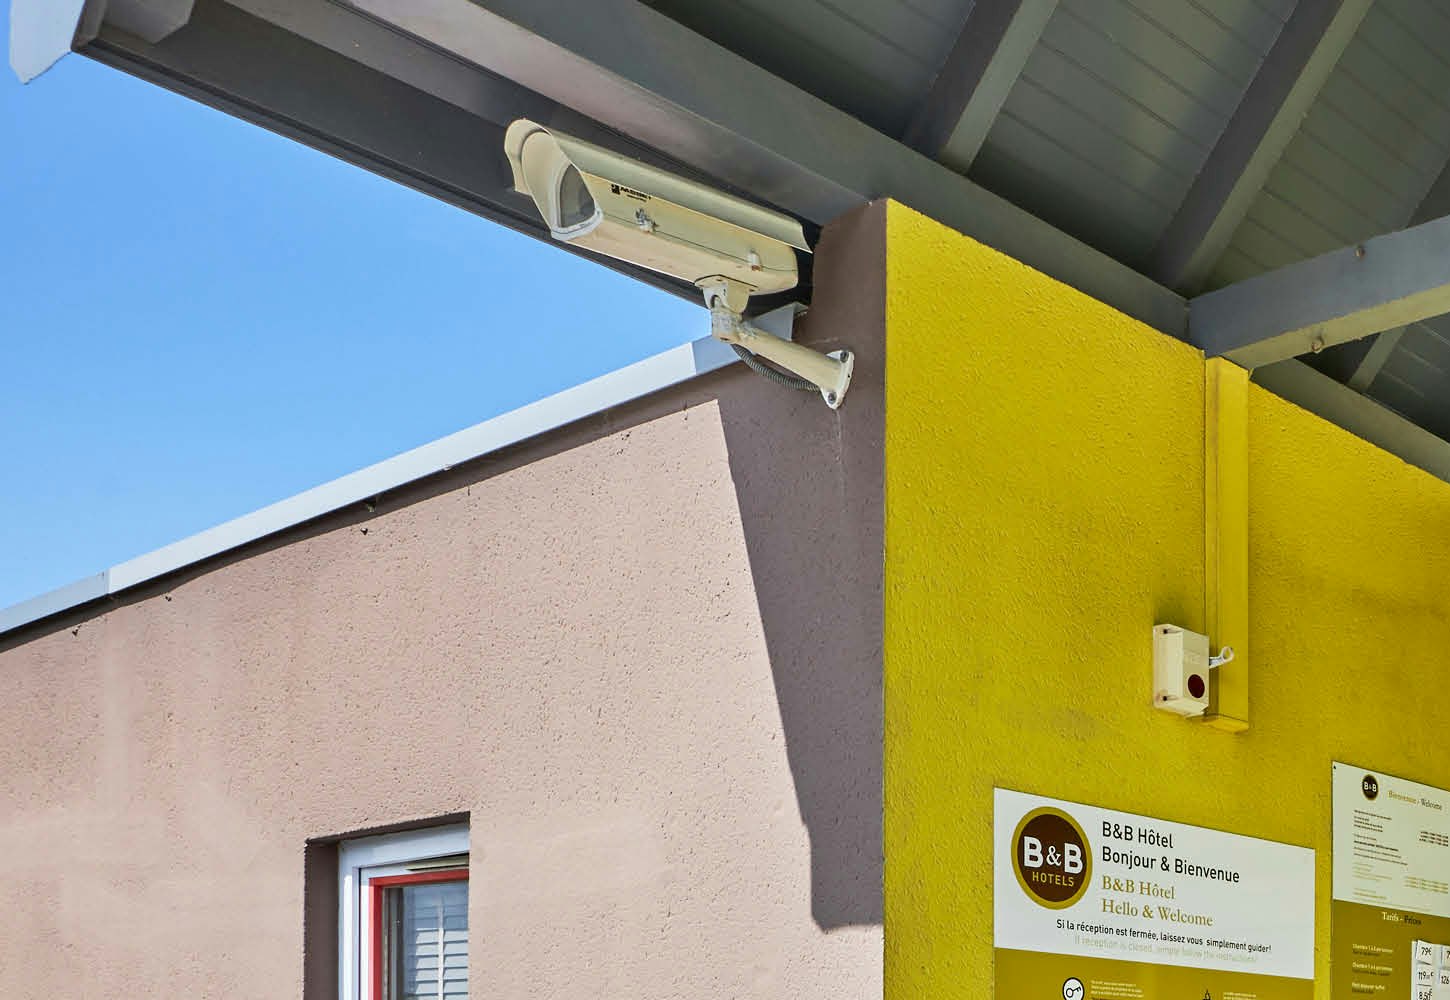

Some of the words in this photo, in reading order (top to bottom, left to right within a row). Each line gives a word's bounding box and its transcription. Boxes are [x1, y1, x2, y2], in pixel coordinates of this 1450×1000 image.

[1102, 821, 1133, 841] B&B
[1138, 828, 1173, 848] Hôtel
[1023, 835, 1083, 874] B&B
[1102, 846, 1157, 869] Bonjour
[1160, 856, 1170, 872] &
[1174, 858, 1240, 883] Bienvenue
[1032, 872, 1074, 887] HOTELS
[1102, 875, 1135, 893] B&B
[1140, 881, 1175, 899] Hôtel
[1102, 898, 1138, 917] Hello
[1142, 904, 1153, 919] &
[1158, 906, 1213, 926] Welcome
[1057, 919, 1065, 929] Si
[1066, 920, 1074, 930] la
[1076, 921, 1113, 935] réception
[1116, 928, 1128, 937] est
[1129, 928, 1159, 941] fermée,
[1160, 931, 1185, 943] laissez
[1206, 938, 1247, 950] simplement
[1248, 943, 1272, 953] guider!
